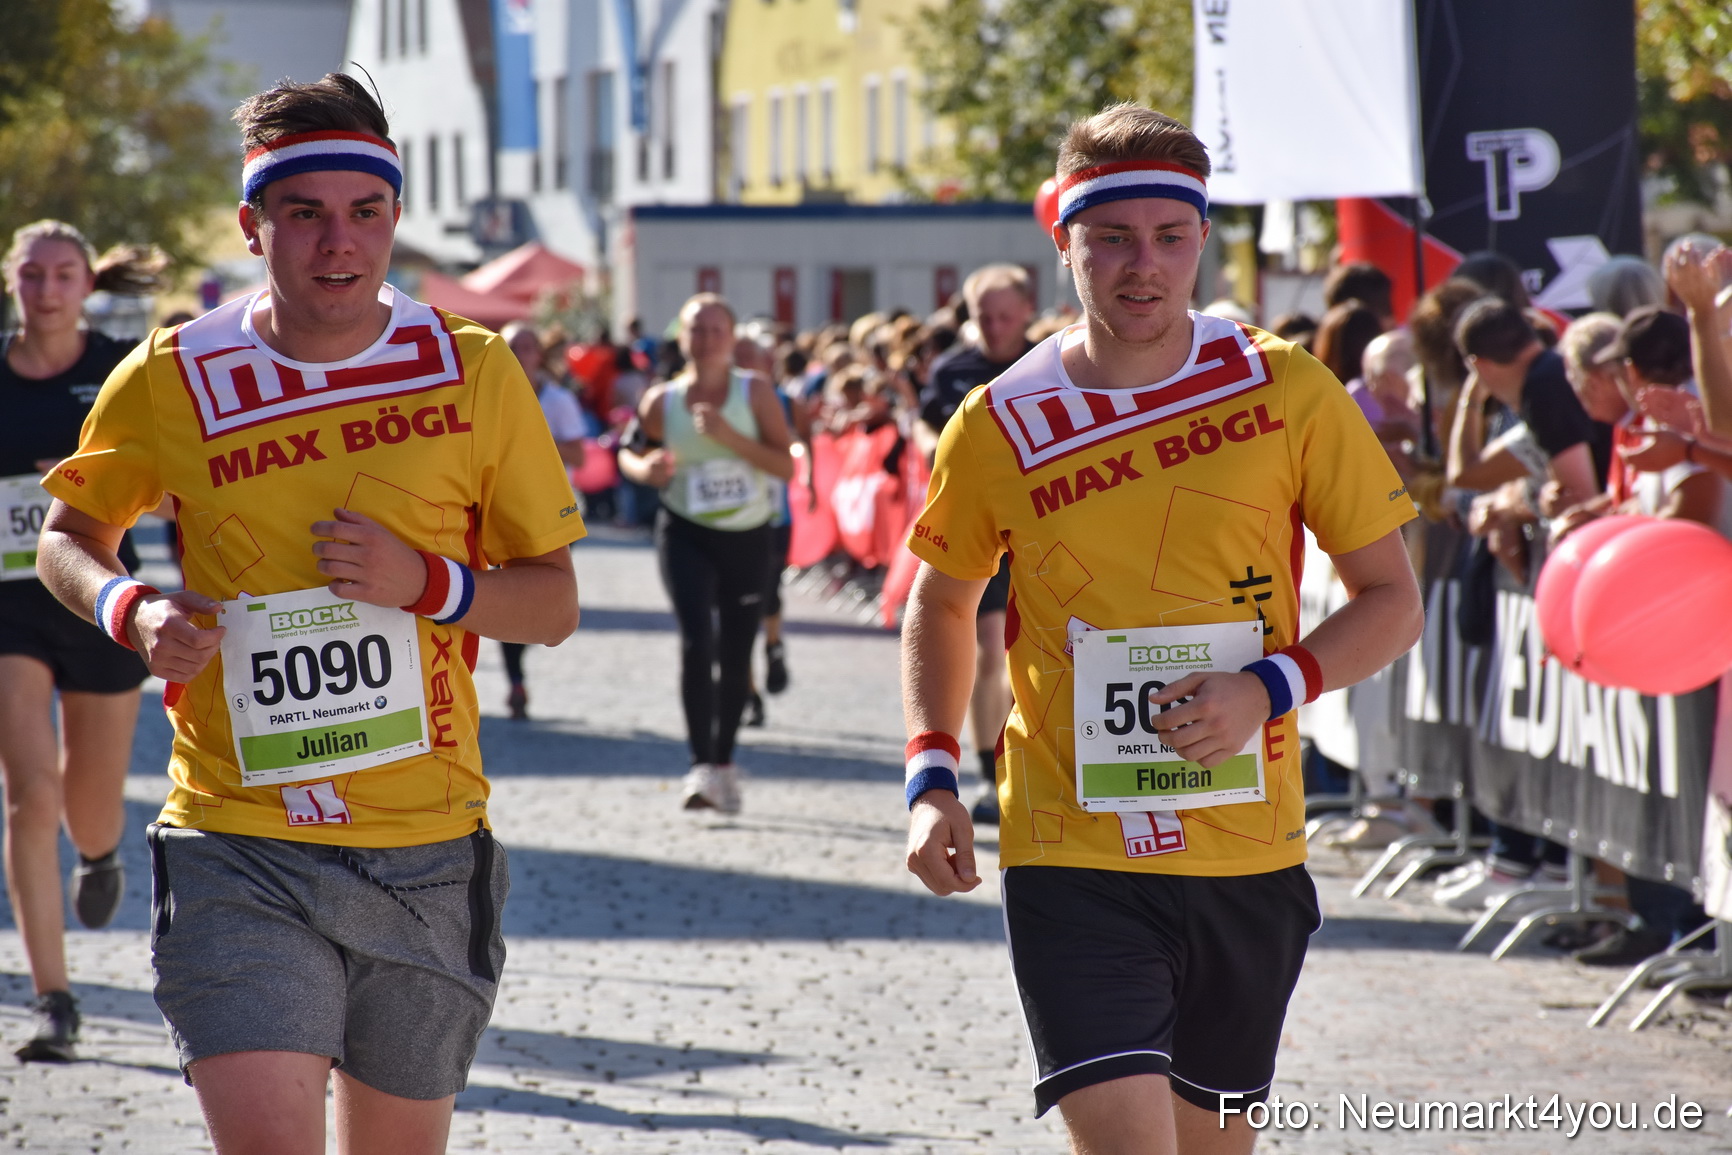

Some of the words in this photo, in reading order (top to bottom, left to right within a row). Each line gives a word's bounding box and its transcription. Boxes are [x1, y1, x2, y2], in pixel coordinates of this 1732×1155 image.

[207, 428, 328, 489] MAX
[340, 403, 472, 454] BÖGL
[1029, 449, 1145, 519] MAX
[1153, 403, 1285, 470] BÖGL
[269, 602, 359, 633] BOCK
[271, 631, 299, 640] inspired
[299, 628, 309, 638] by
[309, 625, 329, 635] smart
[329, 622, 361, 633] concepts
[1128, 643, 1212, 665] BOCK
[1185, 662, 1213, 671] concepts
[251, 634, 392, 707] 5090
[269, 711, 311, 726] PARTL
[313, 700, 371, 720] Neumarkt
[296, 730, 368, 760] Julian
[1117, 744, 1158, 755] PARTL
[1136, 767, 1212, 791] Florian
